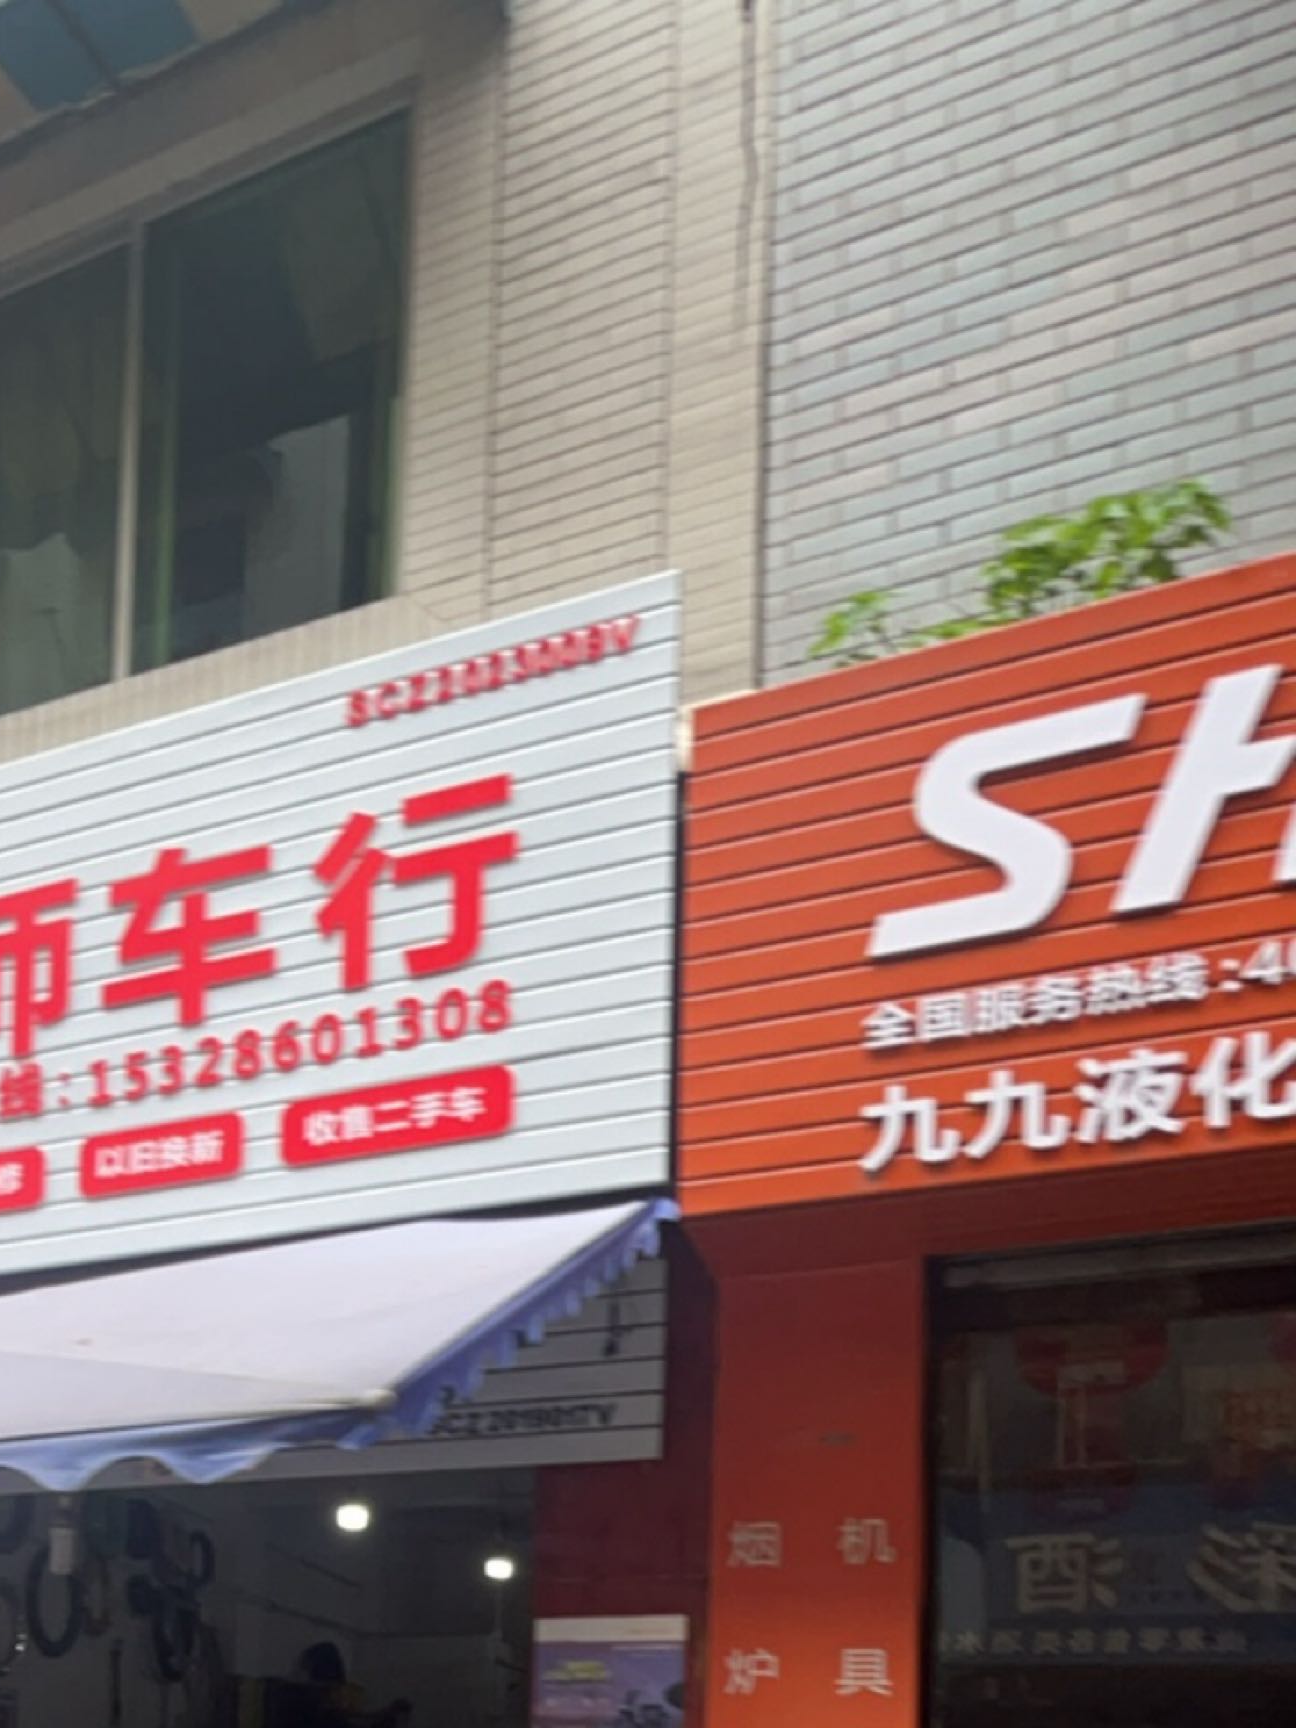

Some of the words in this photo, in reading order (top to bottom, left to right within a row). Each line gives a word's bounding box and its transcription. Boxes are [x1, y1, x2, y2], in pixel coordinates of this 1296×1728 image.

[95, 1129, 225, 1179] 以旧换新
[305, 1085, 487, 1147] 收售二手车
